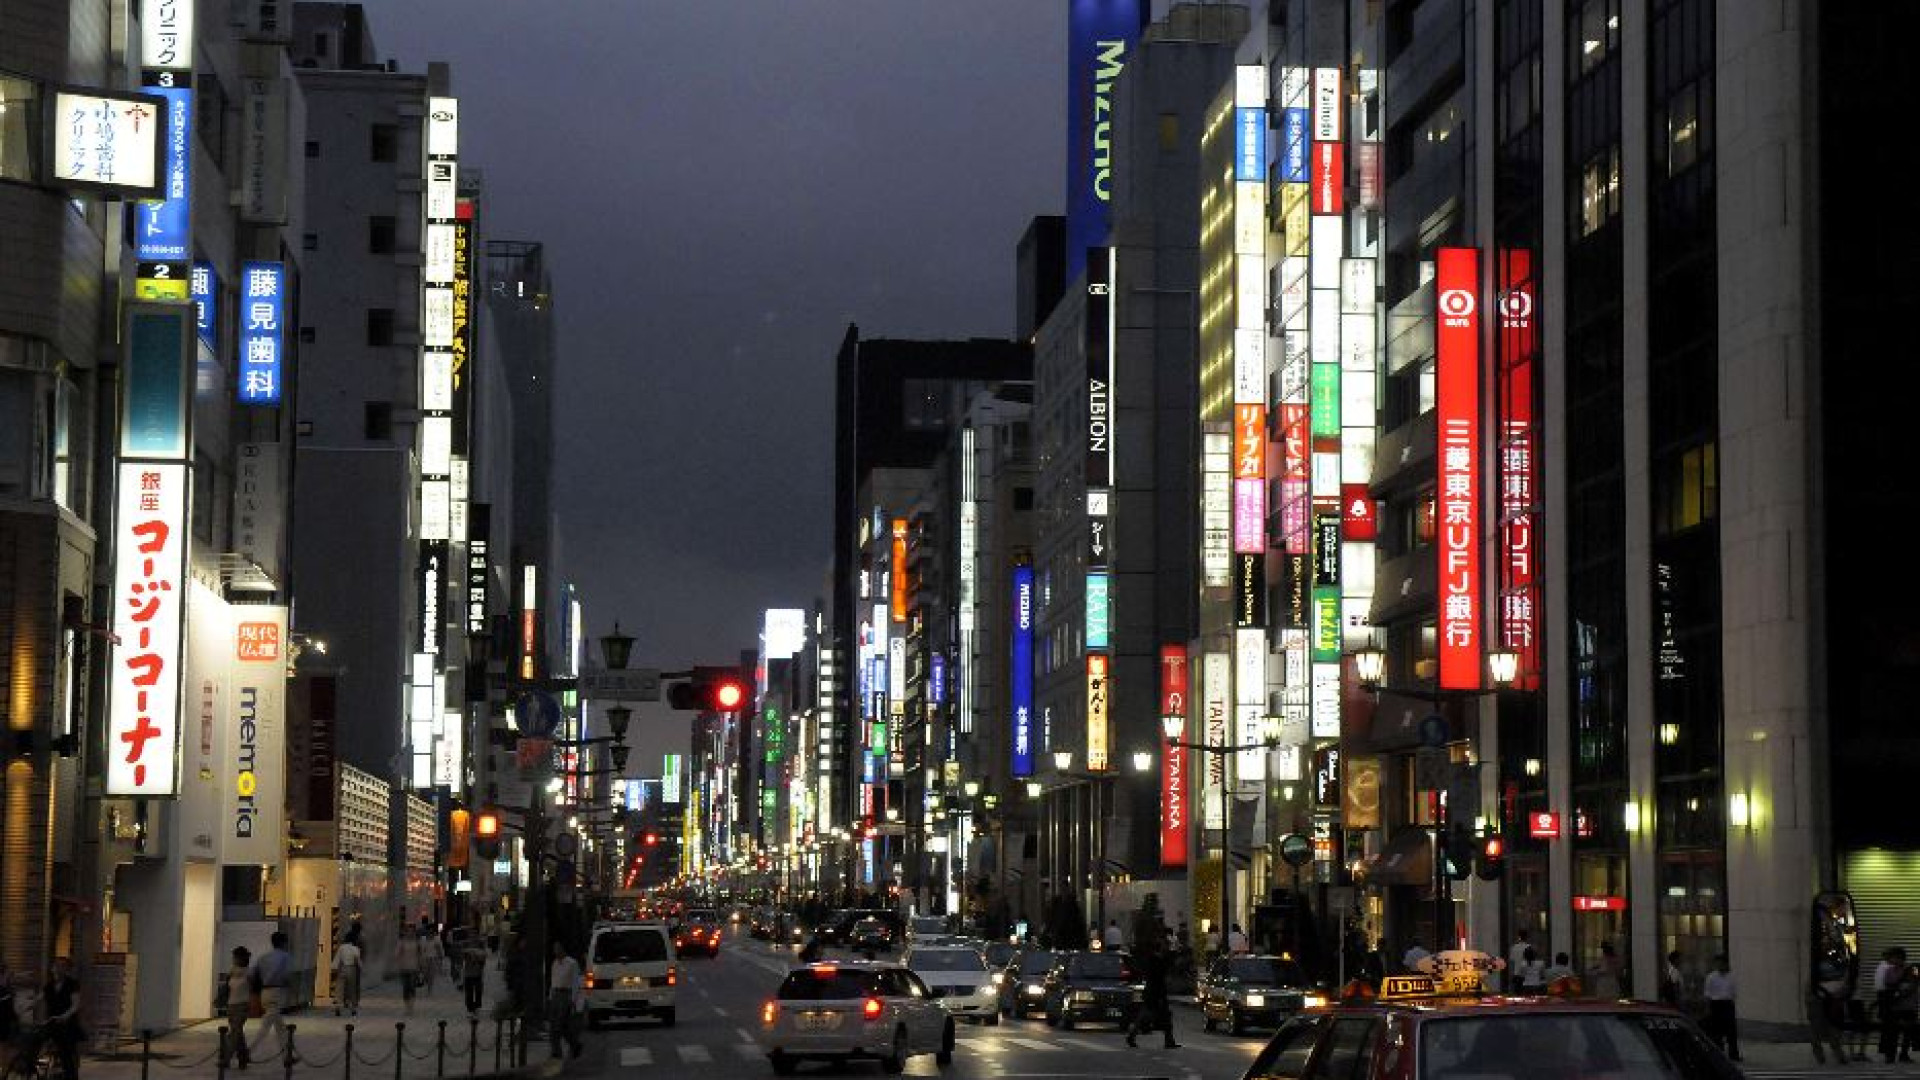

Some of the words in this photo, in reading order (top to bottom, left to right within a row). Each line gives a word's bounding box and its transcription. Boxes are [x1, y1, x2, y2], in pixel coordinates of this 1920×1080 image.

[159, 72, 174, 87] 3
[153, 264, 169, 279] 2
[246, 268, 277, 399] 藤見歯科
[1090, 378, 1106, 452] ALBION
[140, 471, 161, 511] 銀座
[1445, 419, 1471, 647] 三菱東京UFJ銀行
[121, 520, 172, 787] コージーコーナー
[237, 687, 257, 838] memoria
[1169, 755, 1182, 830] TANAKA
